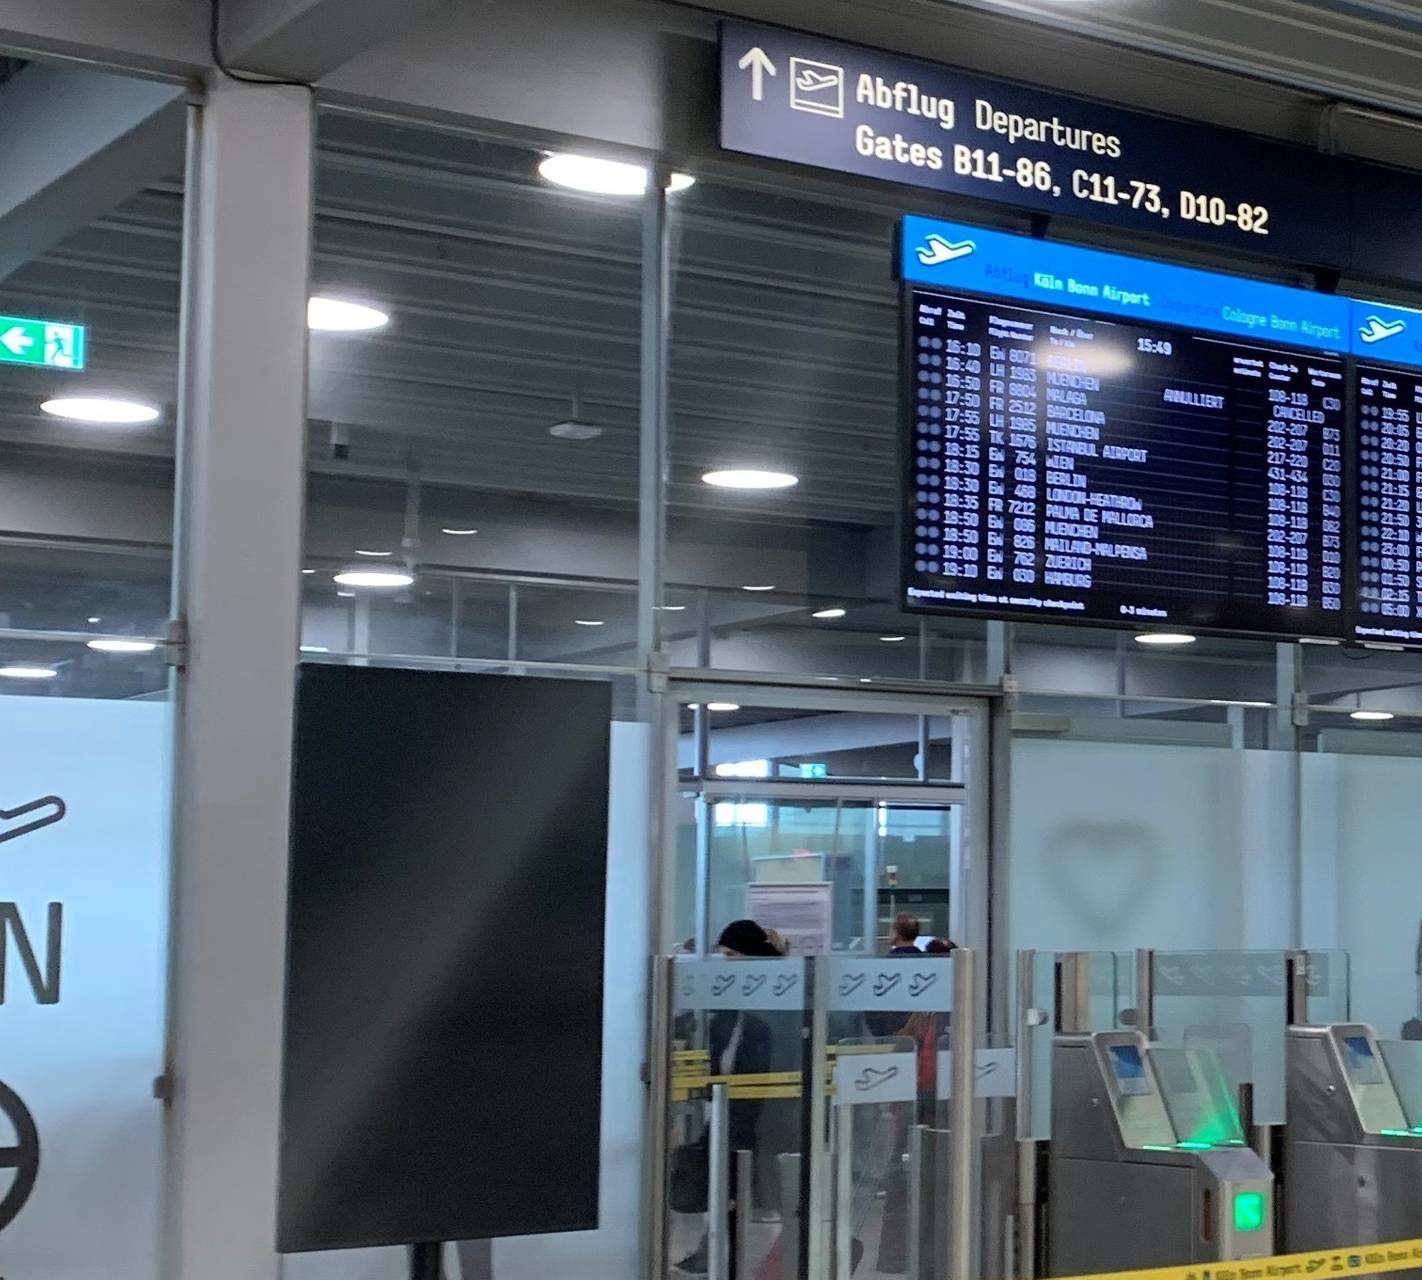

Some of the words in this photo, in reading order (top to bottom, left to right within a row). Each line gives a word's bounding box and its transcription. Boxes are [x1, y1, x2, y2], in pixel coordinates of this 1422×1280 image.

[856, 74, 954, 129] Abflug
[976, 100, 1122, 158] Departures
[855, 125, 943, 170] Gates
[954, 151, 1061, 198] B11-86,
[1073, 168, 1169, 219] C11-73,
[1180, 190, 1269, 235] D10-82
[1033, 271, 1063, 291] Köln
[1067, 278, 1098, 297] Bonn
[1103, 285, 1151, 307] Airport
[1222, 306, 1267, 328] Cologne
[1270, 315, 1299, 332] Bonn
[1301, 322, 1341, 341] Airport
[945, 338, 981, 357] 16:10
[1137, 337, 1172, 356] 15:49
[945, 372, 981, 391] 16:50
[945, 355, 981, 374] 16:40
[1163, 387, 1224, 410] ANNULLIERT
[1272, 403, 1325, 424] CANCELLED
[944, 389, 981, 408] 17:50
[944, 406, 980, 425] 17:55
[944, 424, 980, 442] 17:55
[1102, 444, 1147, 463] AIRPORT
[944, 441, 980, 459] 18:15
[1014, 449, 1036, 465] 754
[1045, 453, 1074, 470] WIEN
[944, 458, 980, 476] 18:30
[1045, 470, 1087, 488] BERLIN
[944, 475, 980, 493] 18:30
[943, 492, 980, 510] 18:35
[1007, 499, 1036, 516] 7212
[943, 509, 980, 527] 18:50
[943, 527, 979, 544] 18:50
[943, 544, 979, 561] 19:00
[943, 561, 979, 578] 19:10
